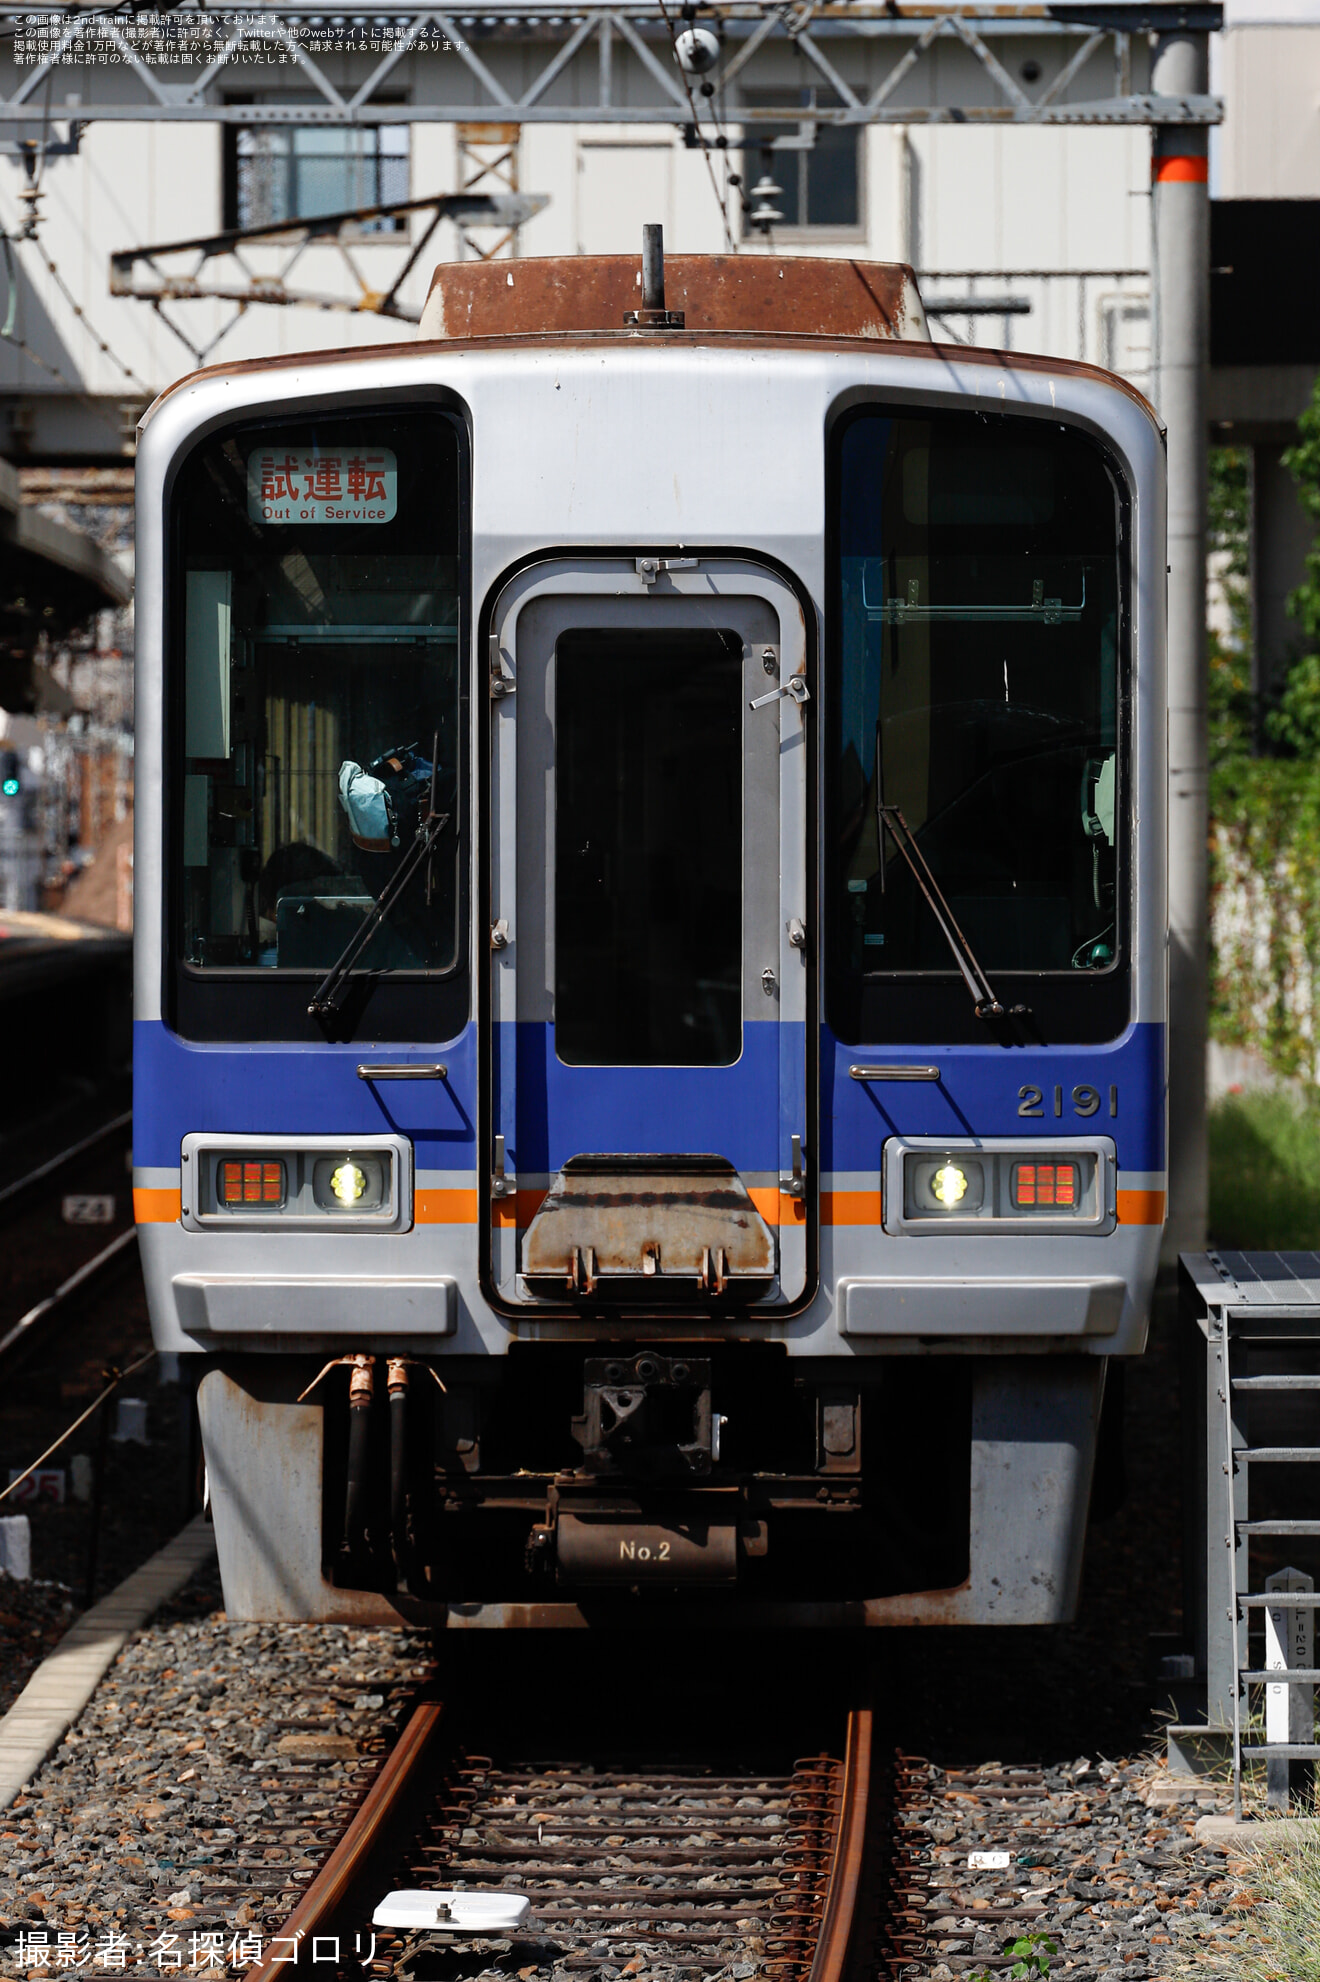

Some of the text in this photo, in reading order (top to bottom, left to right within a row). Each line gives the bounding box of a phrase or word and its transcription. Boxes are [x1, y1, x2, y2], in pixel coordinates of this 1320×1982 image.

[261, 455, 387, 502] 試運転
[262, 506, 386, 519] Out of Service
[1018, 1084, 1118, 1118] 2191
[620, 1541, 671, 1561] No.2
